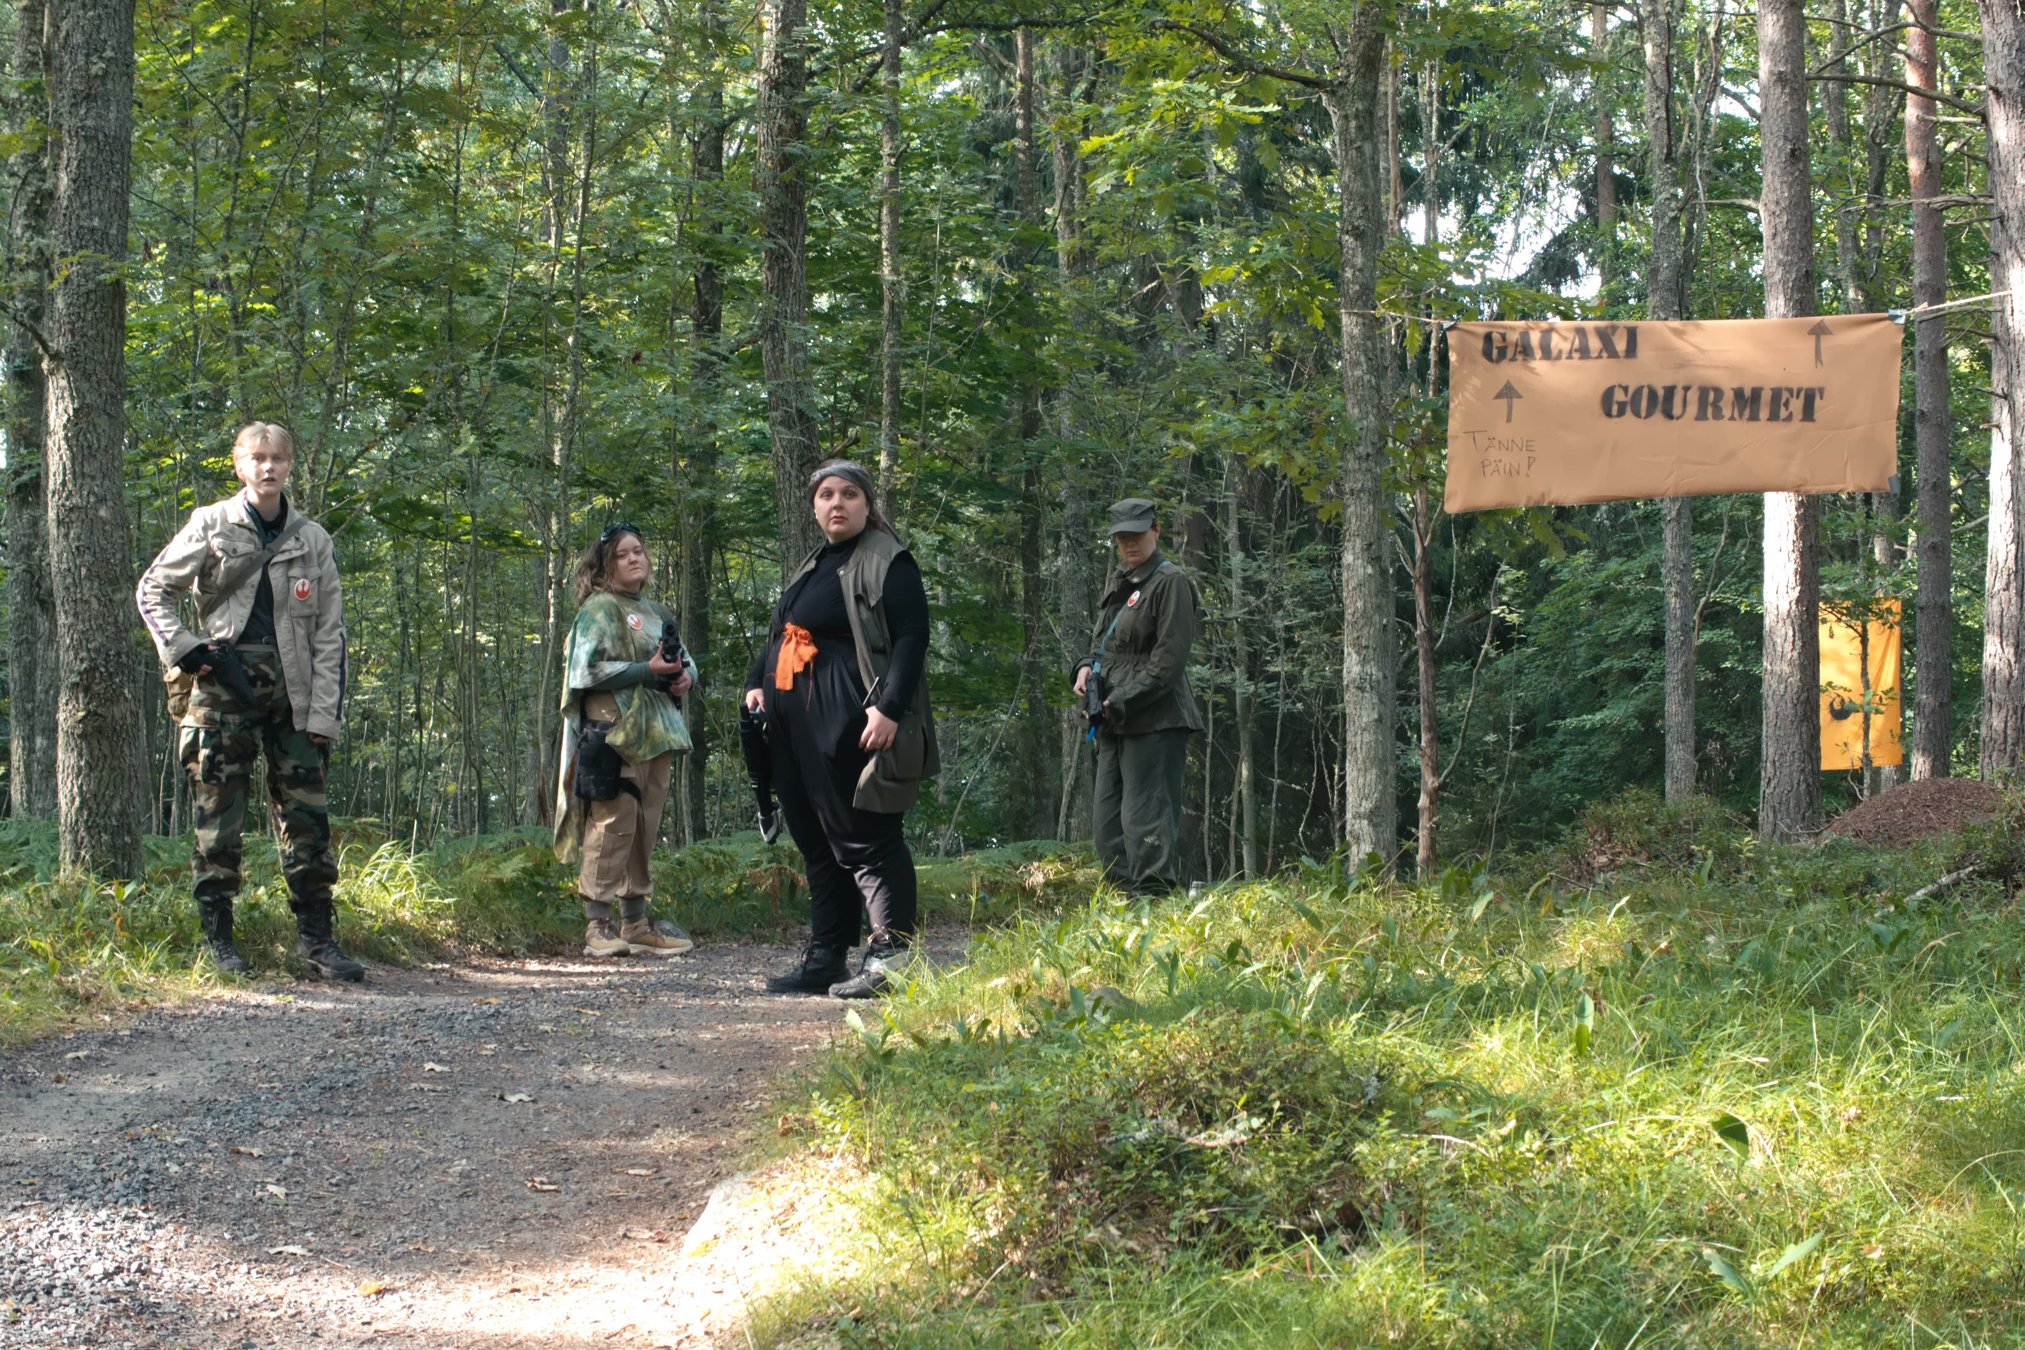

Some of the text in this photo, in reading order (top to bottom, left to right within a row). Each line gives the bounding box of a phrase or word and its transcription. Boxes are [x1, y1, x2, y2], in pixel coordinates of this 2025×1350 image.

[1481, 326, 1639, 364] GALAXI
[1600, 383, 1825, 423] GOURMET
[1462, 430, 1536, 453] TÄNNE
[1481, 456, 1536, 478] PÄIN!
